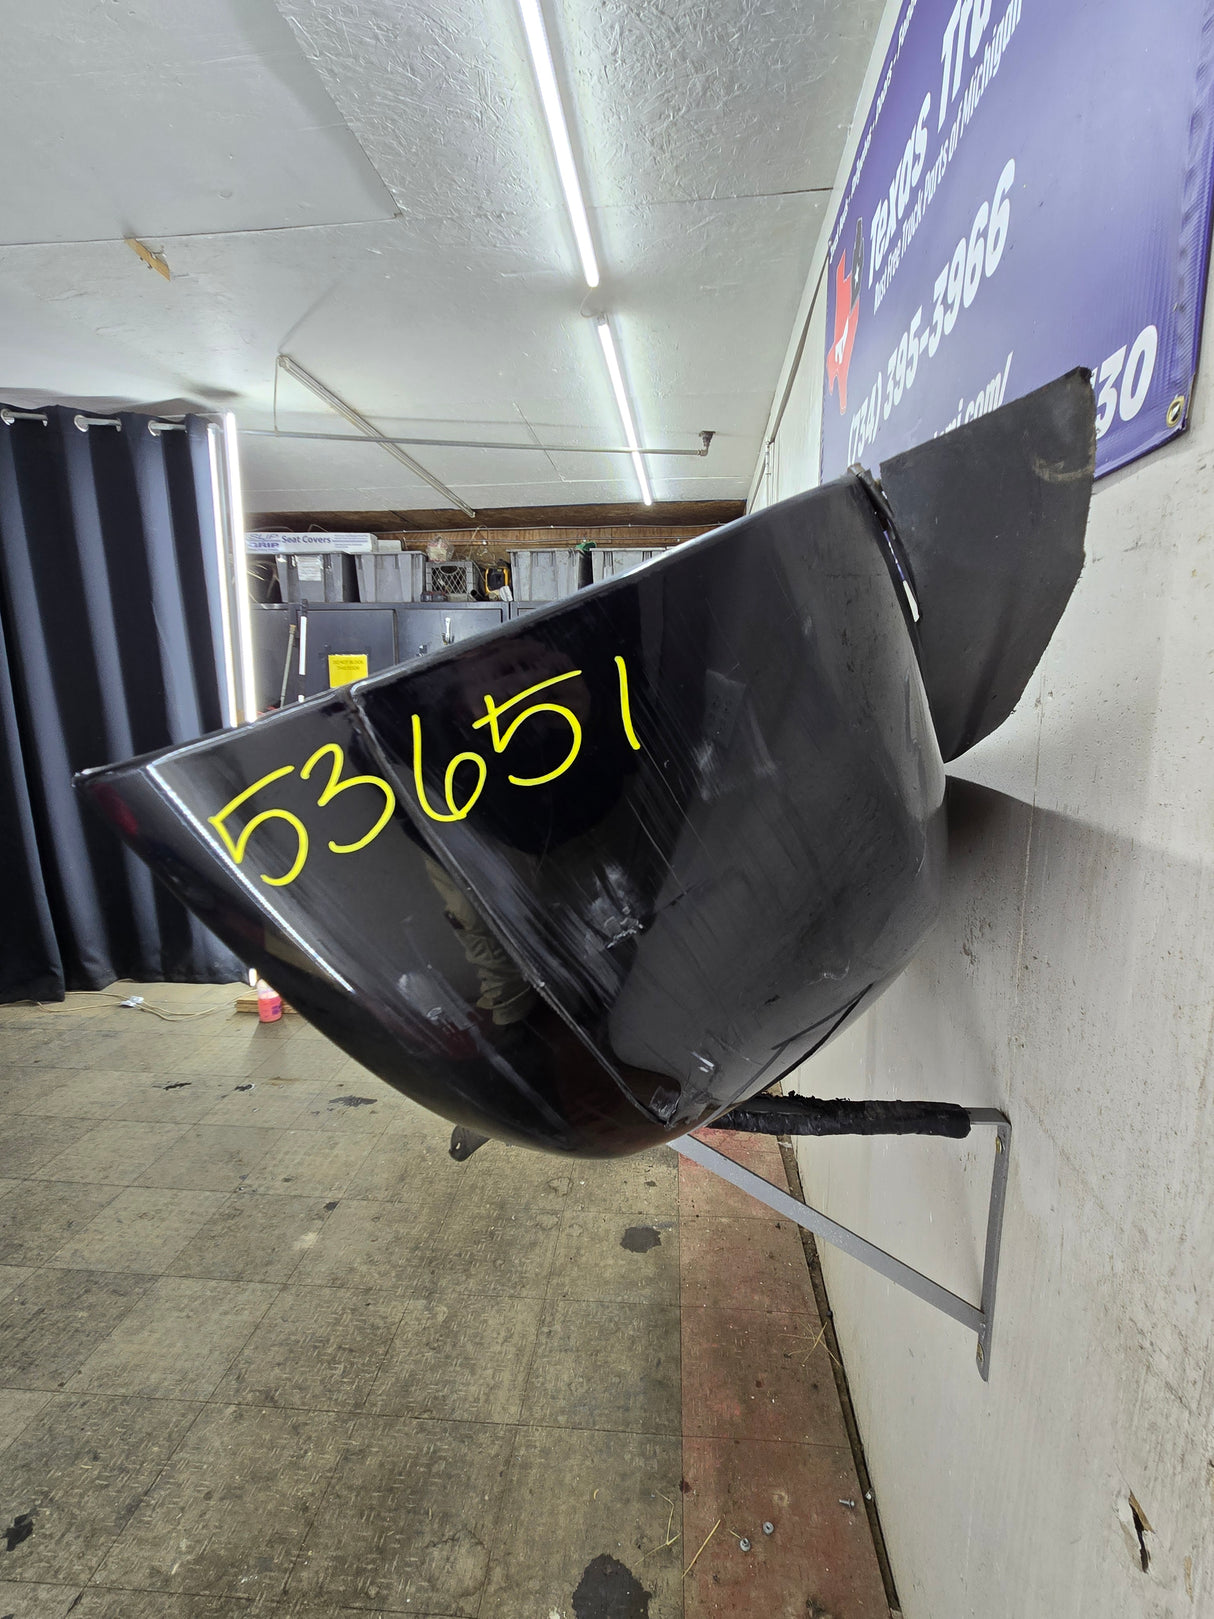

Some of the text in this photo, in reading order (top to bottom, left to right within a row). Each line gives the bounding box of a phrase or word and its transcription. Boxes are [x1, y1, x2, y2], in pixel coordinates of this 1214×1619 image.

[868, 92, 931, 290] Texas
[901, 188, 924, 259] Truck
[922, 137, 949, 216] Parts
[948, 99, 963, 163] of
[959, 0, 1023, 139] Michigan
[847, 158, 1016, 468] (734) 395-3966
[1090, 324, 1158, 440] 30
[281, 535, 301, 544] Seat
[302, 535, 332, 544] Covers
[209, 656, 642, 886] 53651
